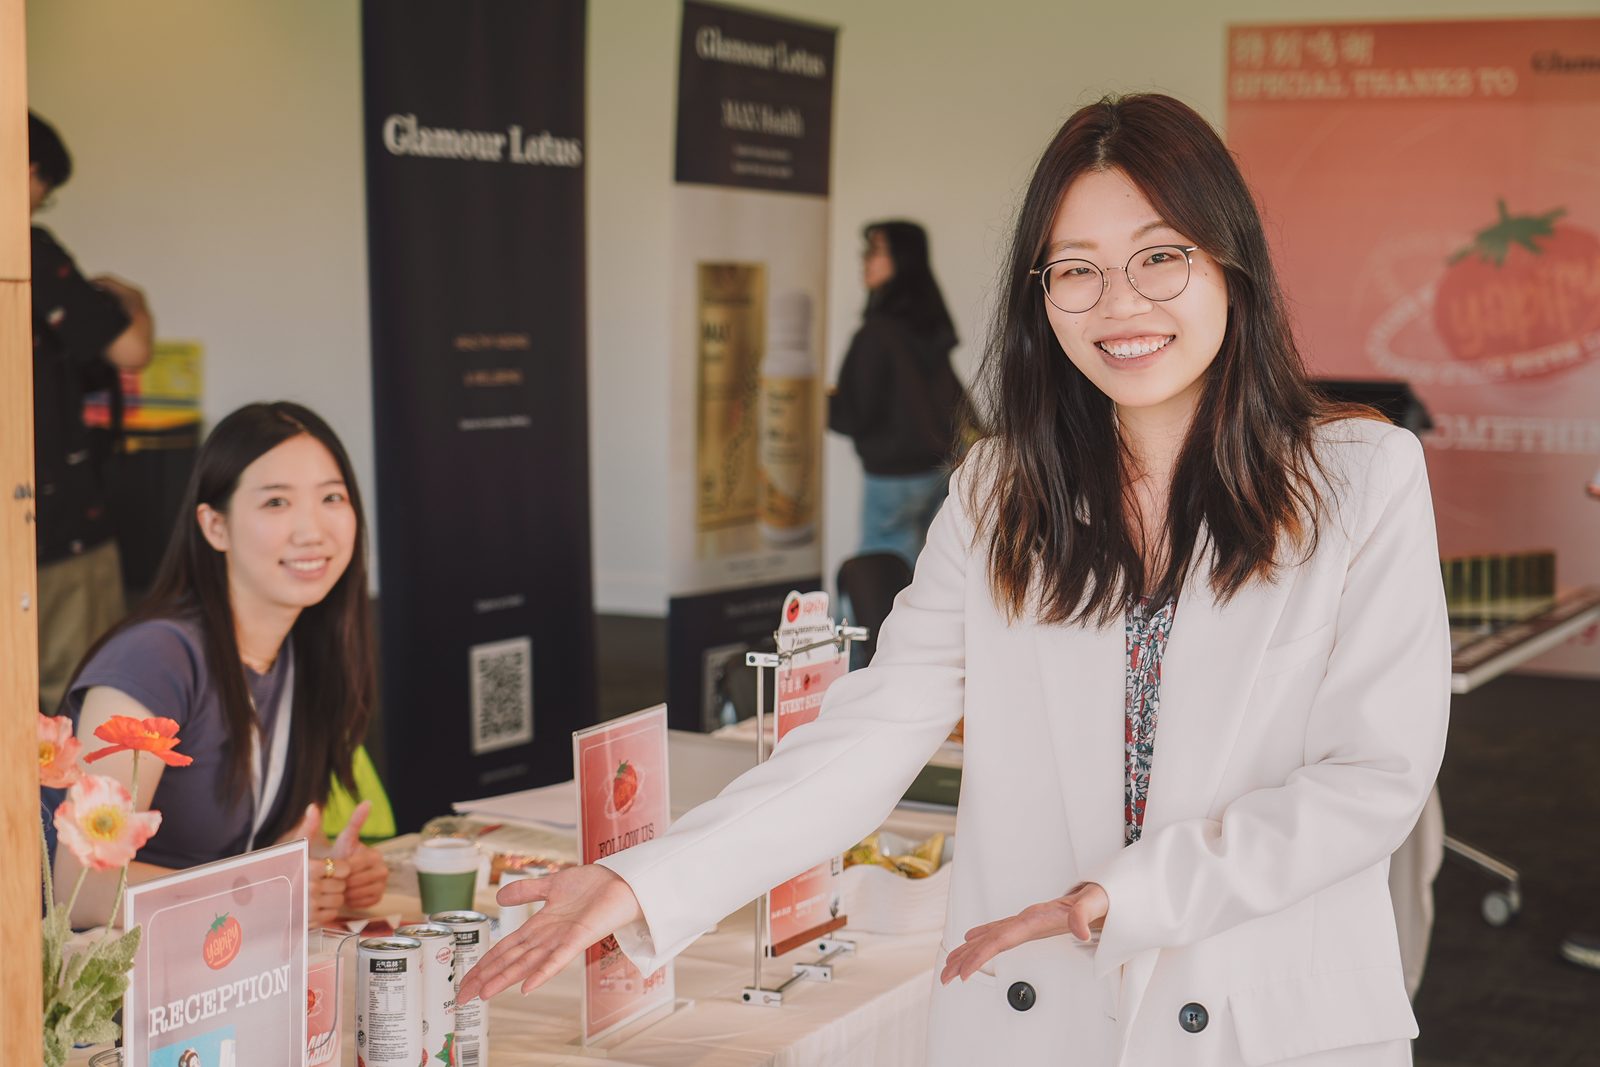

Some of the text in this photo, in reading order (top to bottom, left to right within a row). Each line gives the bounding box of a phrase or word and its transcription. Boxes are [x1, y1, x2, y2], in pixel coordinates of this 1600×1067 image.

[695, 26, 827, 79] Glamour Lotus
[1231, 65, 1519, 98] SPECIAL THANKS TO
[383, 113, 583, 169] Glamour Lotus
[598, 822, 655, 859] FOLLOW US
[206, 923, 239, 963] yapify
[148, 964, 290, 1038] RECEPTION
